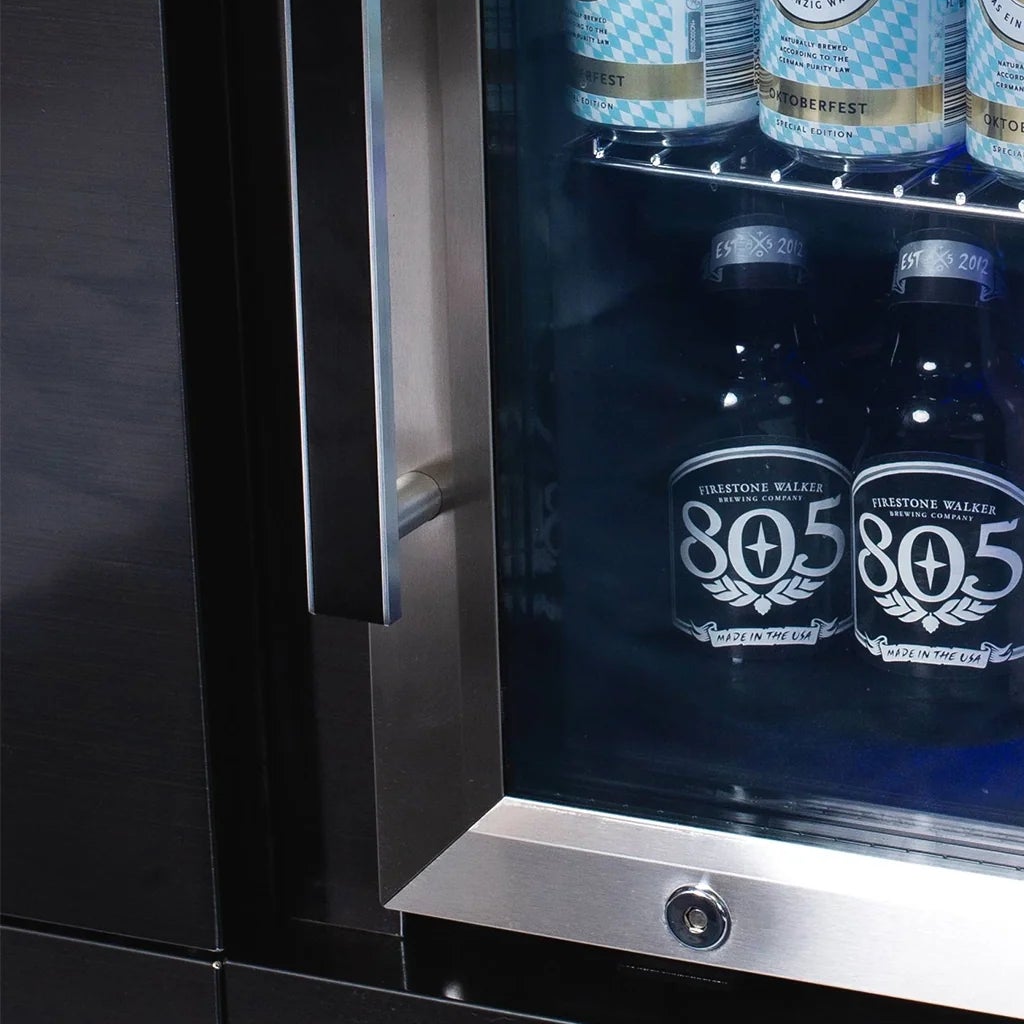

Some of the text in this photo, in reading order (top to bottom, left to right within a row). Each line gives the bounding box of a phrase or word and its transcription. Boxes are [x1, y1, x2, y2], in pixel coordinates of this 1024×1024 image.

[595, 27, 608, 35] THE
[780, 35, 849, 52] NATURALLY BREWED
[779, 46, 849, 63] ACCORDING TO THE
[778, 56, 804, 69] GERMAN
[806, 62, 832, 72] PURITY
[995, 82, 1024, 93] GERMAN
[581, 97, 613, 110] EDITION
[769, 87, 868, 114] OKTOBERFEST
[776, 119, 853, 139] SPECIAL EDITION
[901, 249, 989, 275] EST 2012
[698, 481, 824, 496] FIRESTONE WALKER
[718, 494, 803, 503] BREWING COMPANY
[871, 497, 997, 516] FIRESTONE WALKER
[930, 512, 974, 522] COMPANY
[680, 493, 846, 585] 805
[858, 512, 1023, 603] 805
[716, 630, 813, 642] MADE IN THE USA
[887, 648, 981, 663] MADE IN THE USA
